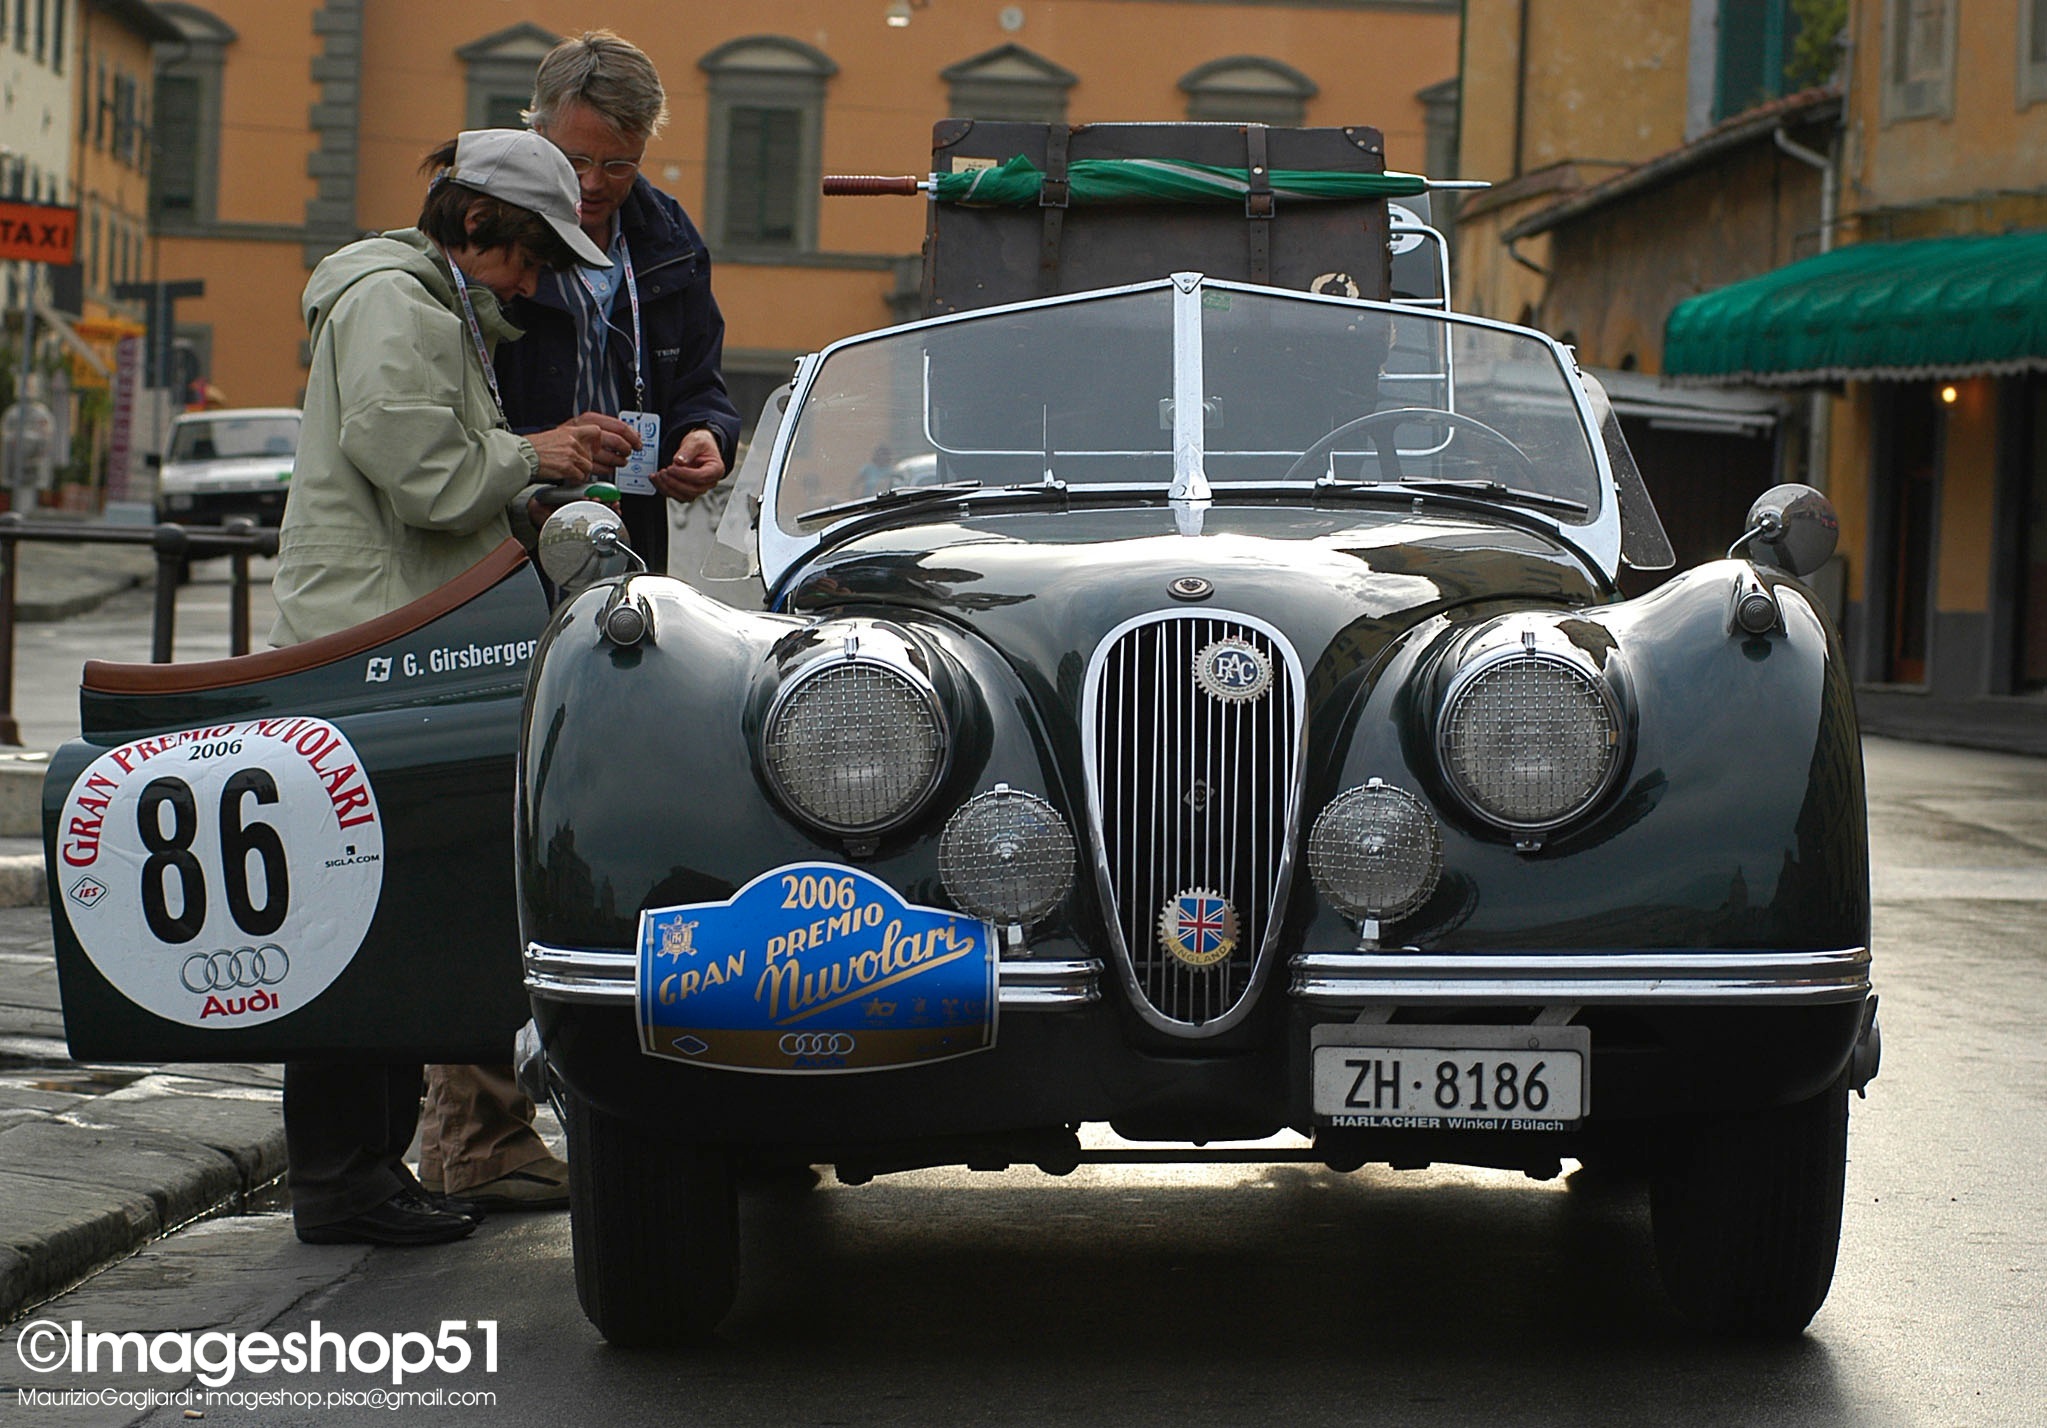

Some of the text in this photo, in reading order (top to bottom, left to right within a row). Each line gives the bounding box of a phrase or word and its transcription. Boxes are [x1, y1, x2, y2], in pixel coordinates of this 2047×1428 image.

[0, 219, 69, 248] TAXI
[403, 639, 537, 677] G. Girsberger
[1216, 653, 1254, 685] RAC
[188, 739, 242, 761] 2006
[63, 719, 375, 867] GRAN PREMIO NUVOLARI
[136, 767, 290, 944] 86
[325, 854, 380, 868] SIGLA.COM
[781, 875, 856, 910] 2006
[659, 903, 884, 1006] GRAN PREMIO
[1172, 944, 1227, 963] ENGLAND
[755, 918, 974, 1024] Nuvolari
[200, 989, 279, 1019] Audi
[1332, 1116, 1440, 1128] HARLACHER
[1447, 1117, 1498, 1130] Winkel
[1512, 1118, 1563, 1131] Bülach
